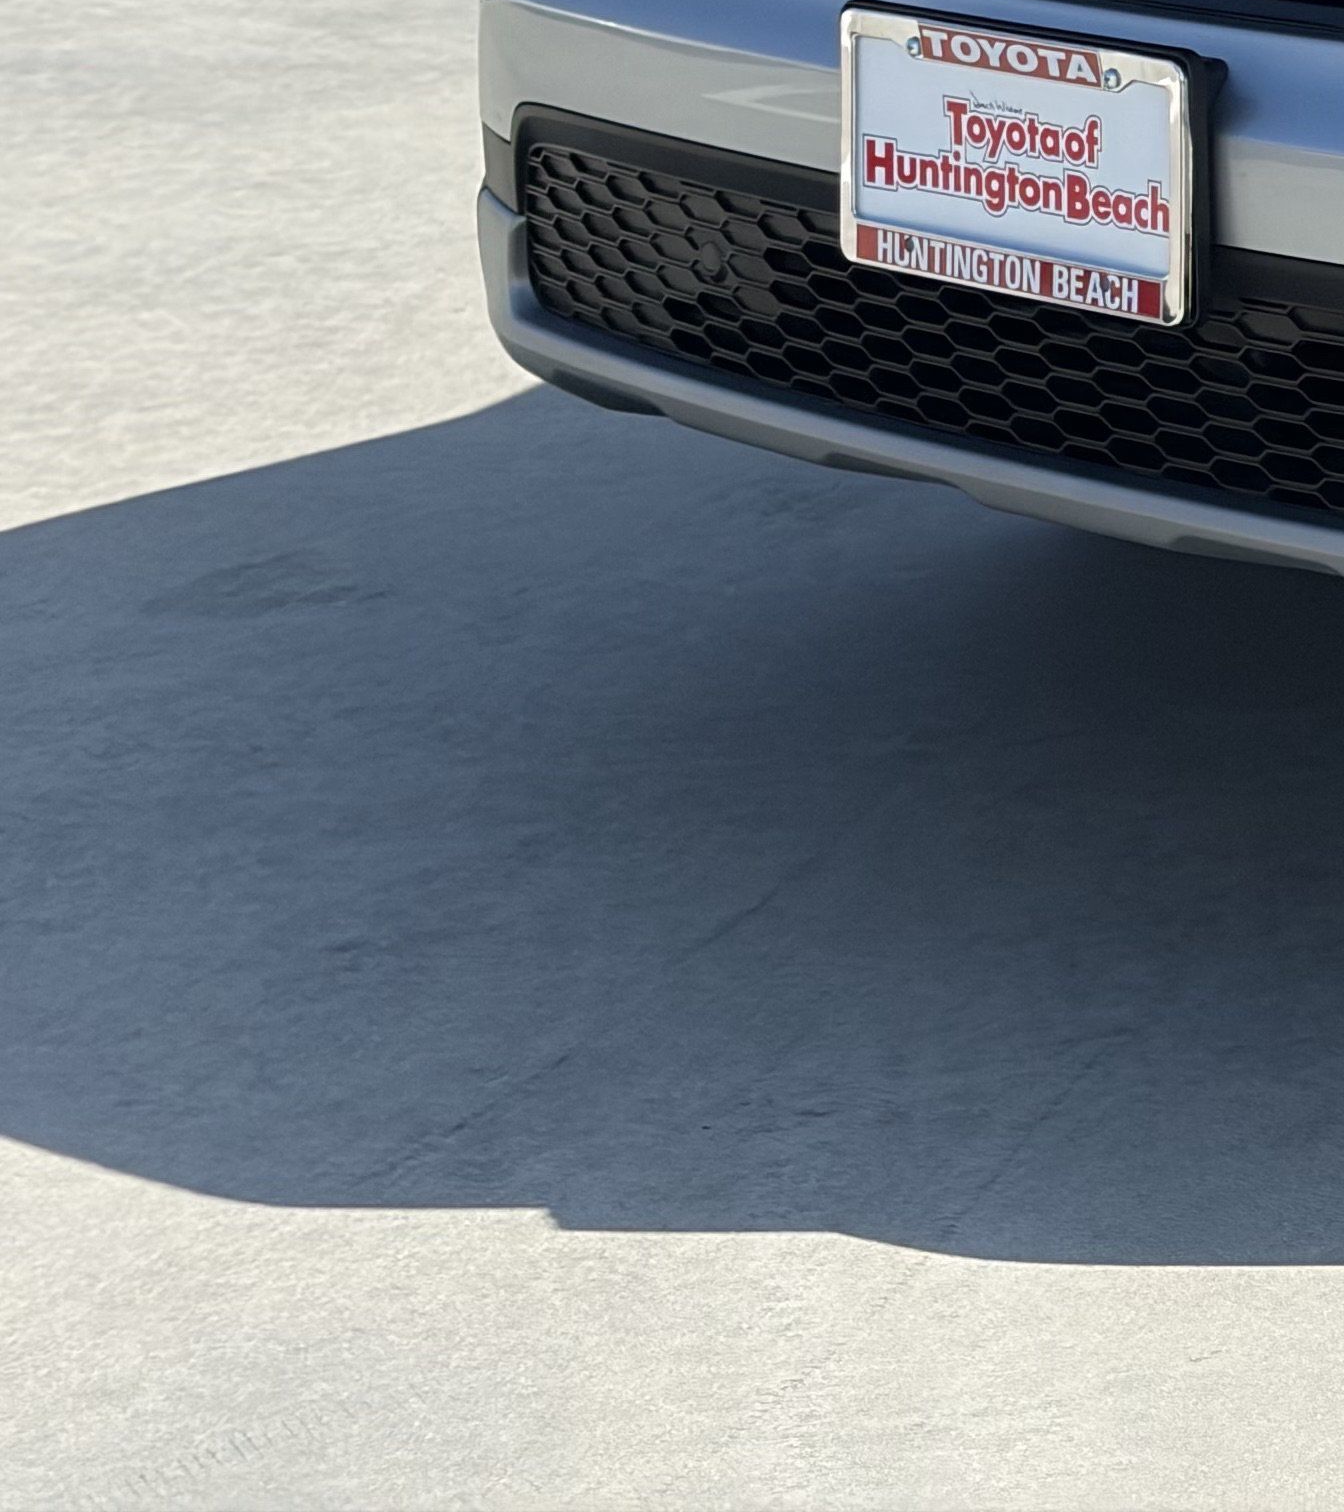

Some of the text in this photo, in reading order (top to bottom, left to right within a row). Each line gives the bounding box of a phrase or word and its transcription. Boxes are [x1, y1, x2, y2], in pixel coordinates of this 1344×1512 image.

[920, 30, 1098, 84] TOYOTA
[877, 230, 1139, 314] HUNTINGTON BEACH
